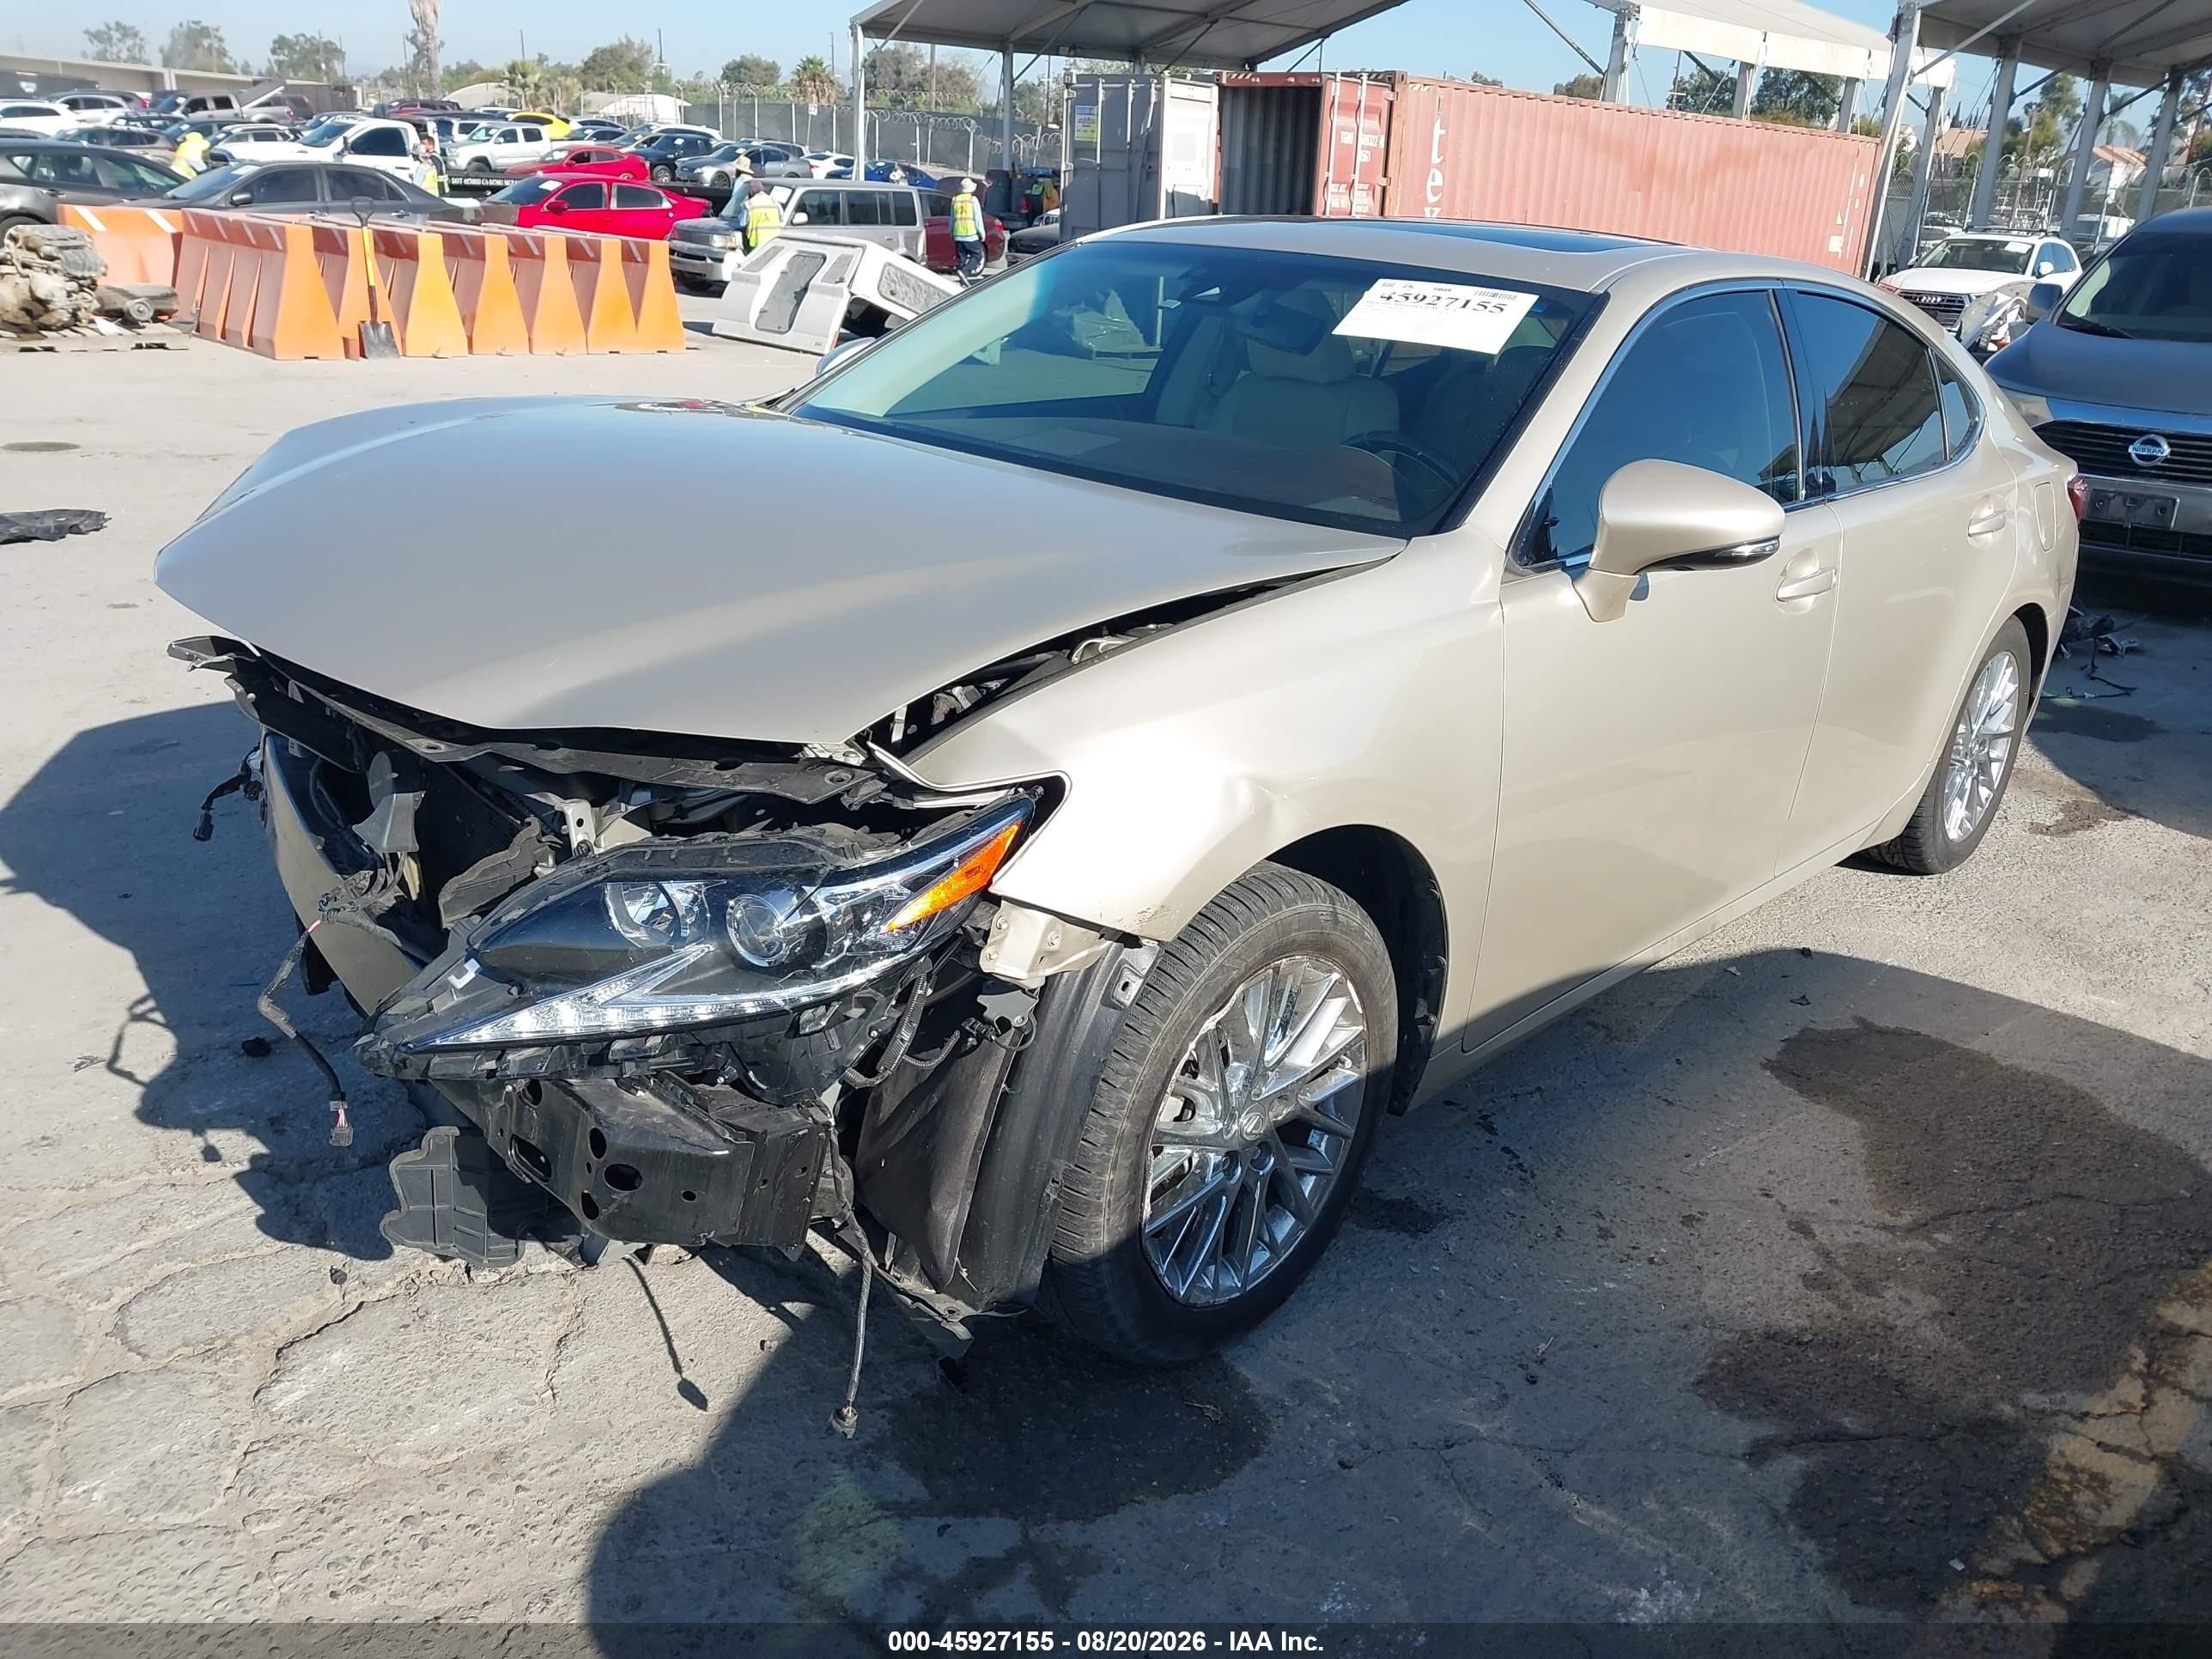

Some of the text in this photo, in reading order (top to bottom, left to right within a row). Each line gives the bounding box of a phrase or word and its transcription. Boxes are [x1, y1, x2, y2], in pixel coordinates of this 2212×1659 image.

[1423, 117, 1447, 218] te
[1380, 291, 1508, 314] 45927155
[2132, 447, 2165, 455] NISSAN
